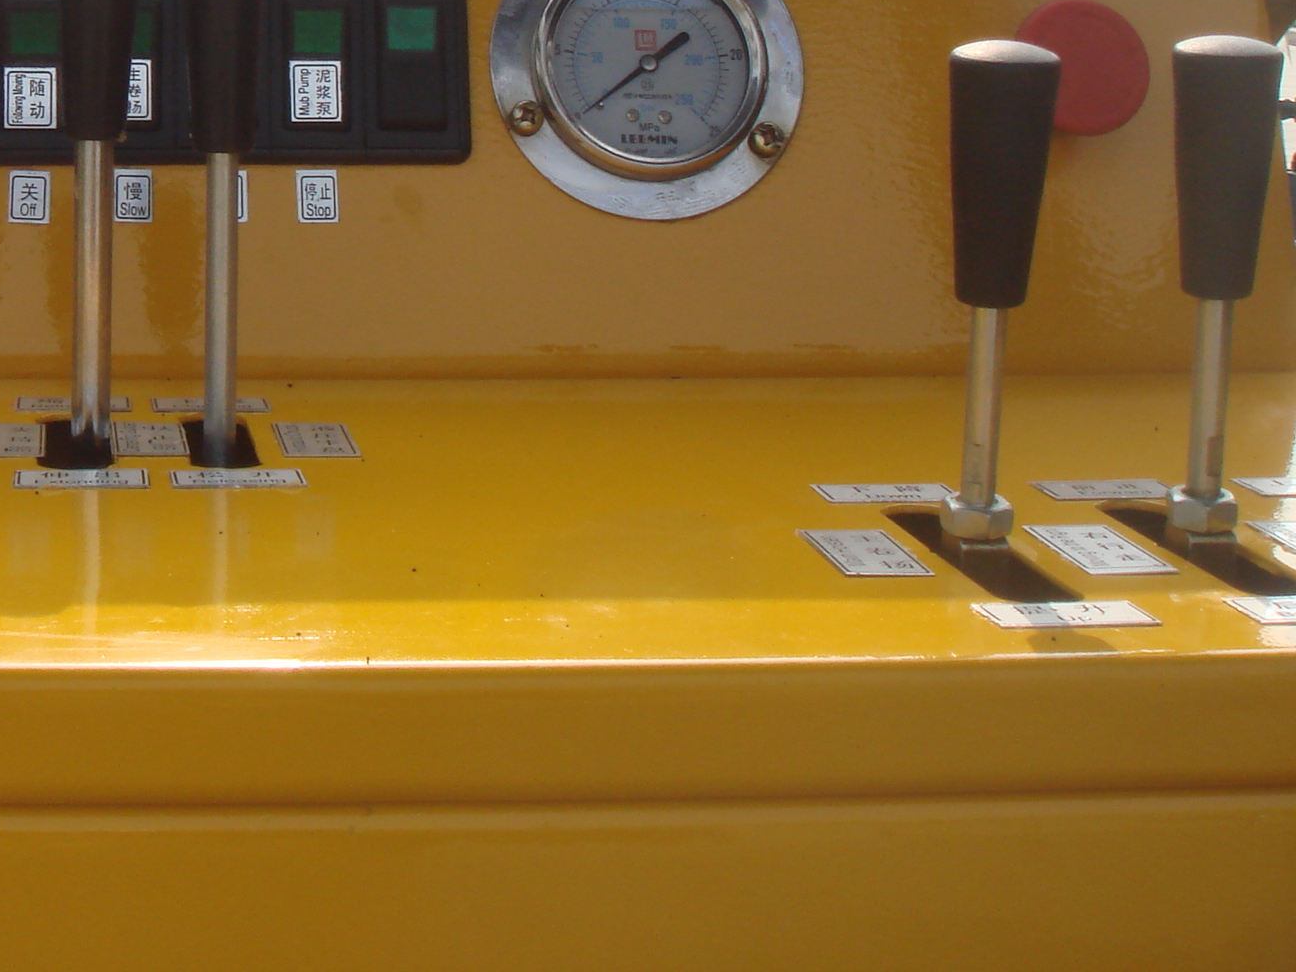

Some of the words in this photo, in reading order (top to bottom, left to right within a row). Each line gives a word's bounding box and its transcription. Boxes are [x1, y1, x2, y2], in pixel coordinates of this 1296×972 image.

[614, 17, 630, 28] 100
[661, 19, 677, 29] 150
[685, 54, 703, 66] 200
[730, 48, 742, 61] 20
[12, 74, 26, 95] Moving
[298, 68, 311, 94] Pump
[29, 79, 45, 119] 随动
[315, 69, 332, 115] 泥浆泵
[298, 97, 310, 115] Mub
[676, 94, 694, 106] 250
[12, 96, 26, 123] Following
[639, 123, 660, 131] MPa
[621, 134, 678, 144] LEEMIN
[20, 182, 38, 201] 关
[123, 182, 142, 200] 慢
[305, 182, 332, 201] 停止
[20, 203, 37, 216] Off
[120, 202, 147, 216] Slow
[306, 203, 331, 218] Stop
